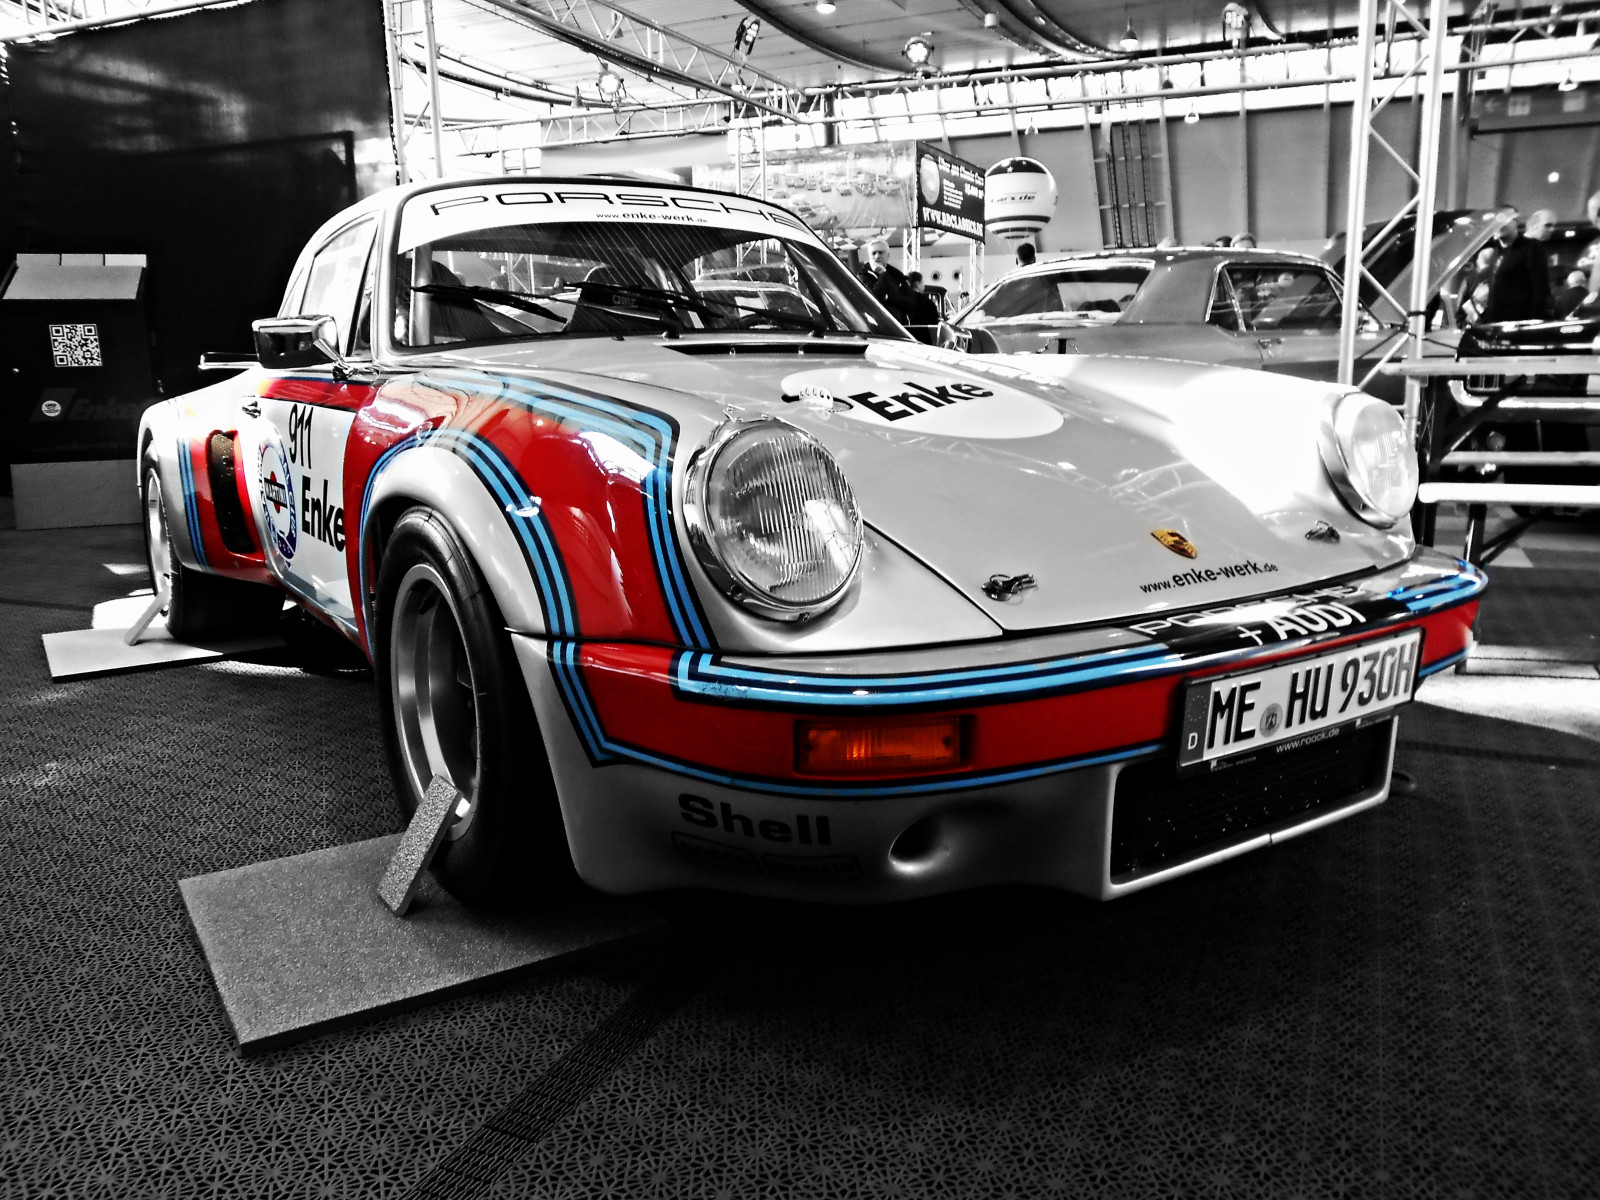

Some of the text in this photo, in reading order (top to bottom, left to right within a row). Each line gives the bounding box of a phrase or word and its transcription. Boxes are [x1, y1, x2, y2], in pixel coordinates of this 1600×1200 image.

[430, 191, 808, 236] PORSCHE
[596, 212, 708, 223] www.enke-werk.de
[848, 381, 994, 422] Enke
[288, 403, 314, 470] 911
[301, 474, 346, 552] Enke
[1140, 560, 1278, 594] www.enke-werk.de
[1268, 601, 1367, 641] AUDI
[1187, 641, 1418, 750] D ME HU 930H
[1275, 728, 1340, 753] www.roock.de
[678, 793, 832, 845] Shell
